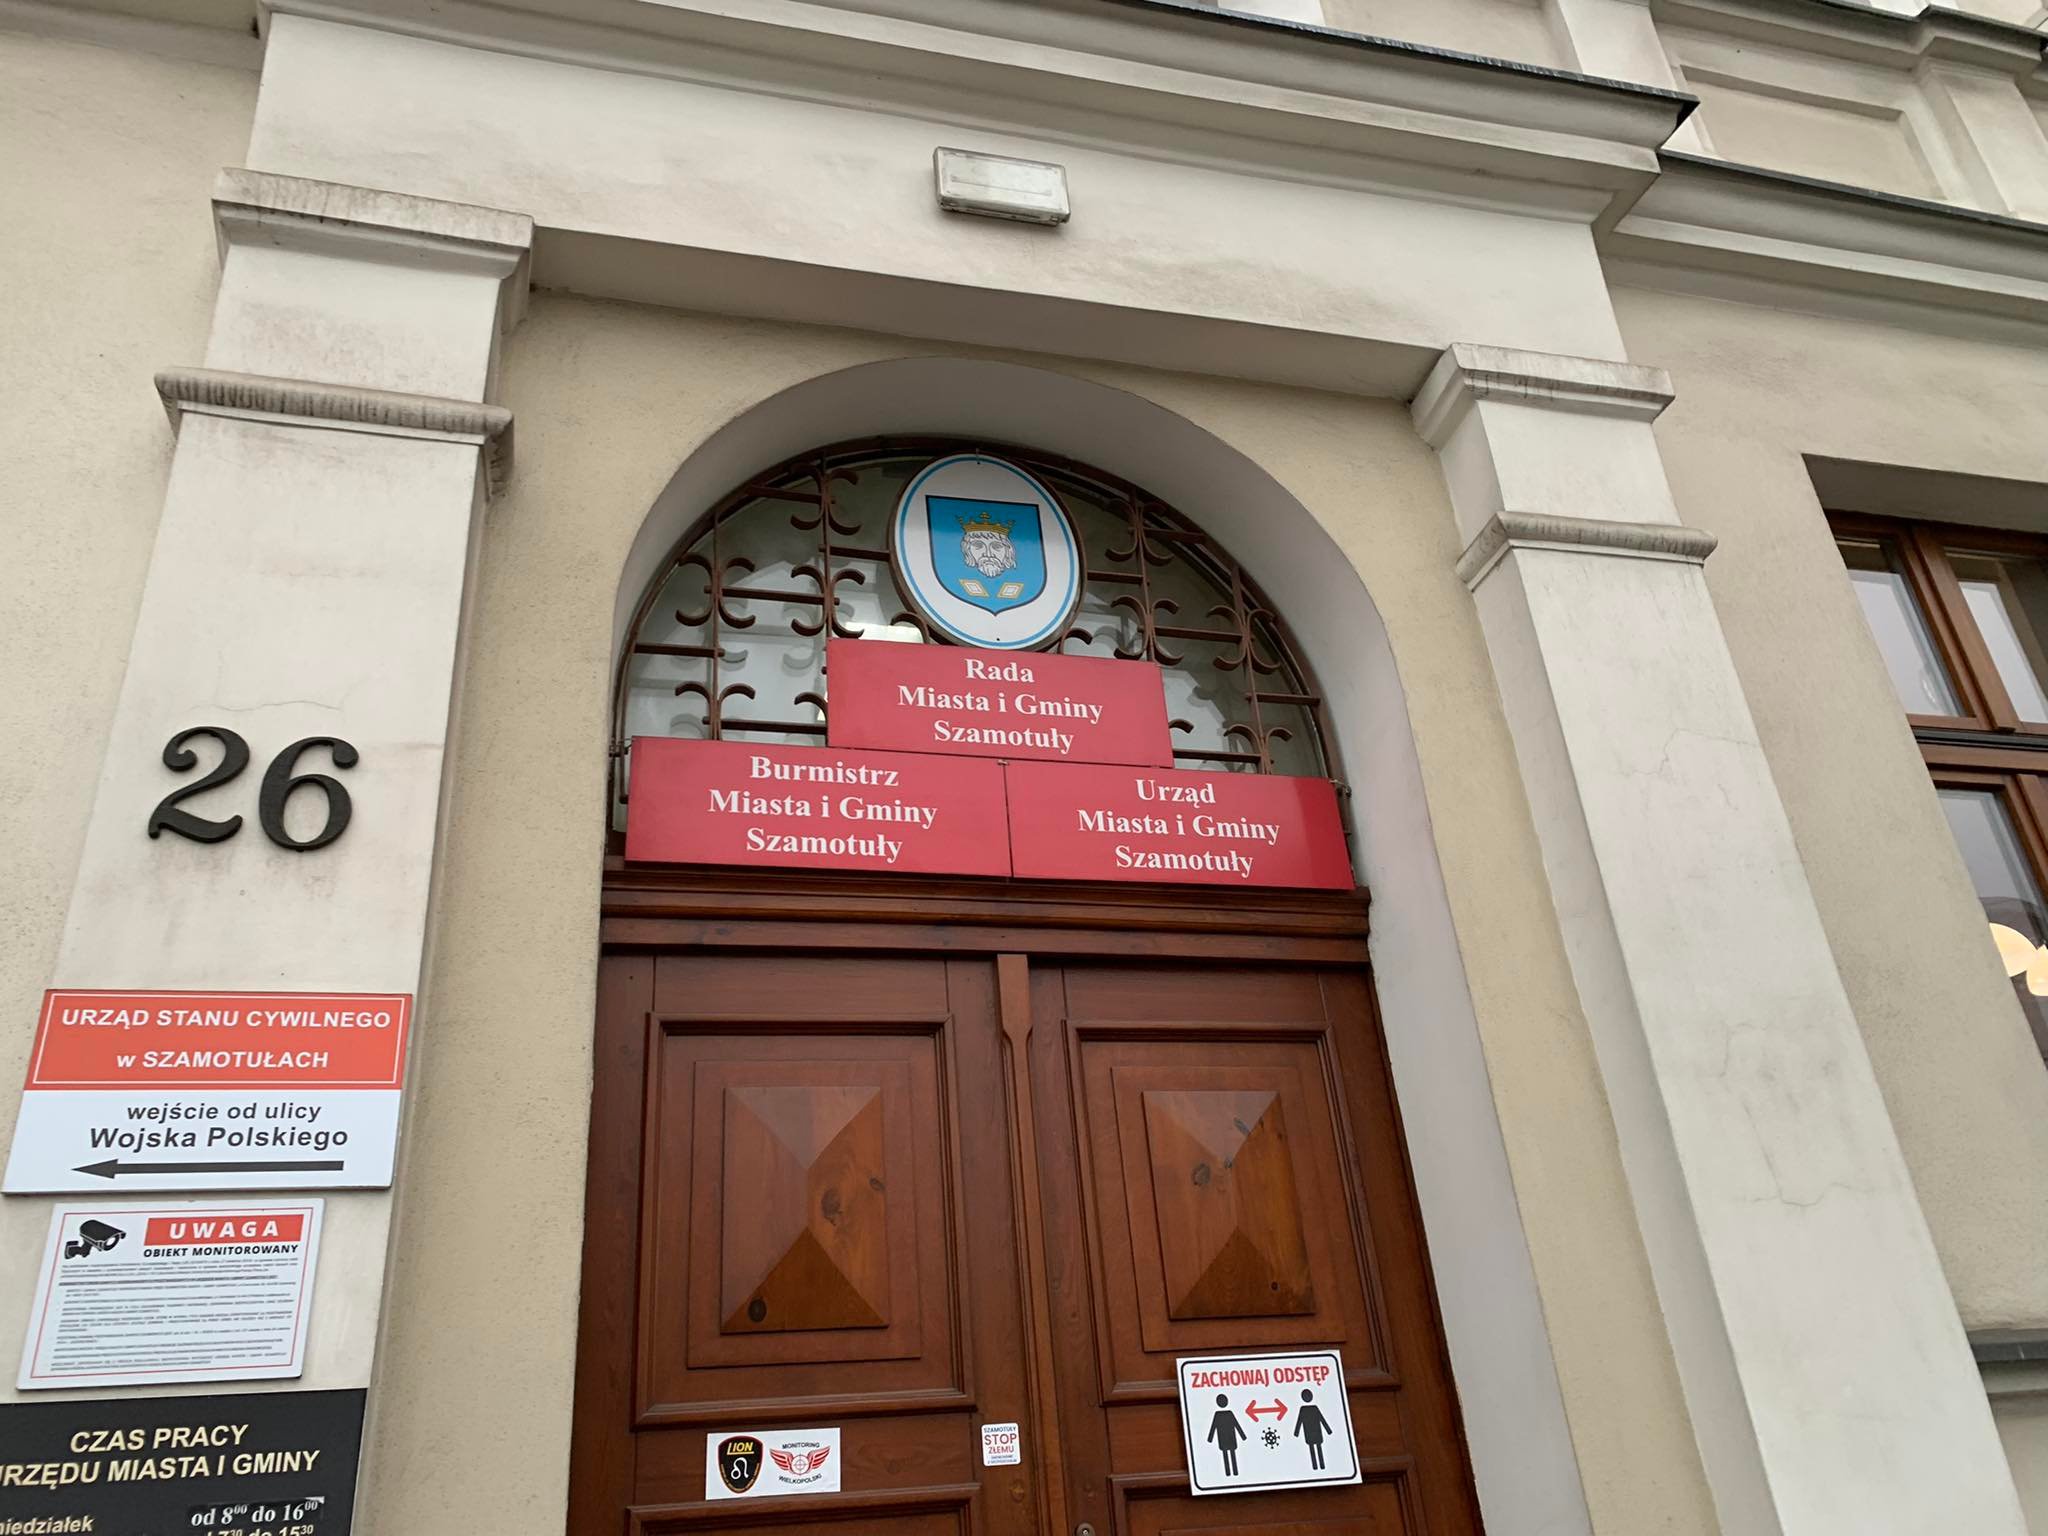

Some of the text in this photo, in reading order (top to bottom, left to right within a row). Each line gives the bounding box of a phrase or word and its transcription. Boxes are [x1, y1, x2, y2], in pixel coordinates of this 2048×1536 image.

[965, 658, 1034, 684] Rada
[897, 685, 1103, 725] Miasta i Gminy
[933, 720, 1075, 754] Szamotuły
[750, 756, 899, 787] Burmistrz
[148, 726, 359, 852] 26
[1135, 778, 1216, 809] Urząd
[707, 789, 938, 830] Miasta i Gminy
[1077, 809, 1280, 846] Miasta i Gminy
[746, 828, 903, 864] Szamotuły
[1115, 845, 1253, 878] Szamotuły
[62, 1009, 391, 1030] URZĄD STANU CYWILNEGO
[116, 1051, 329, 1068] w SZAMOTUŁACH
[127, 1102, 321, 1124] wejście od ulicy
[90, 1127, 349, 1153] Wojska Polskiego
[169, 1220, 279, 1240] UWAGA
[143, 1244, 298, 1258] OBIEKT MONITOROWANY
[1191, 1365, 1330, 1388] ZACHOWAJ ODSTĘP
[70, 1424, 248, 1453] CZAS PRACY
[727, 1441, 755, 1455] LION
[984, 1433, 1017, 1445] STOP
[989, 1445, 1014, 1454] ZŁEMU
[0, 1450, 320, 1490] RZĘDU MIASTA I GMINY
[779, 1473, 822, 1484] WIELKOPOLSKI
[191, 1508, 216, 1526] od
[252, 1505, 276, 1522] do
